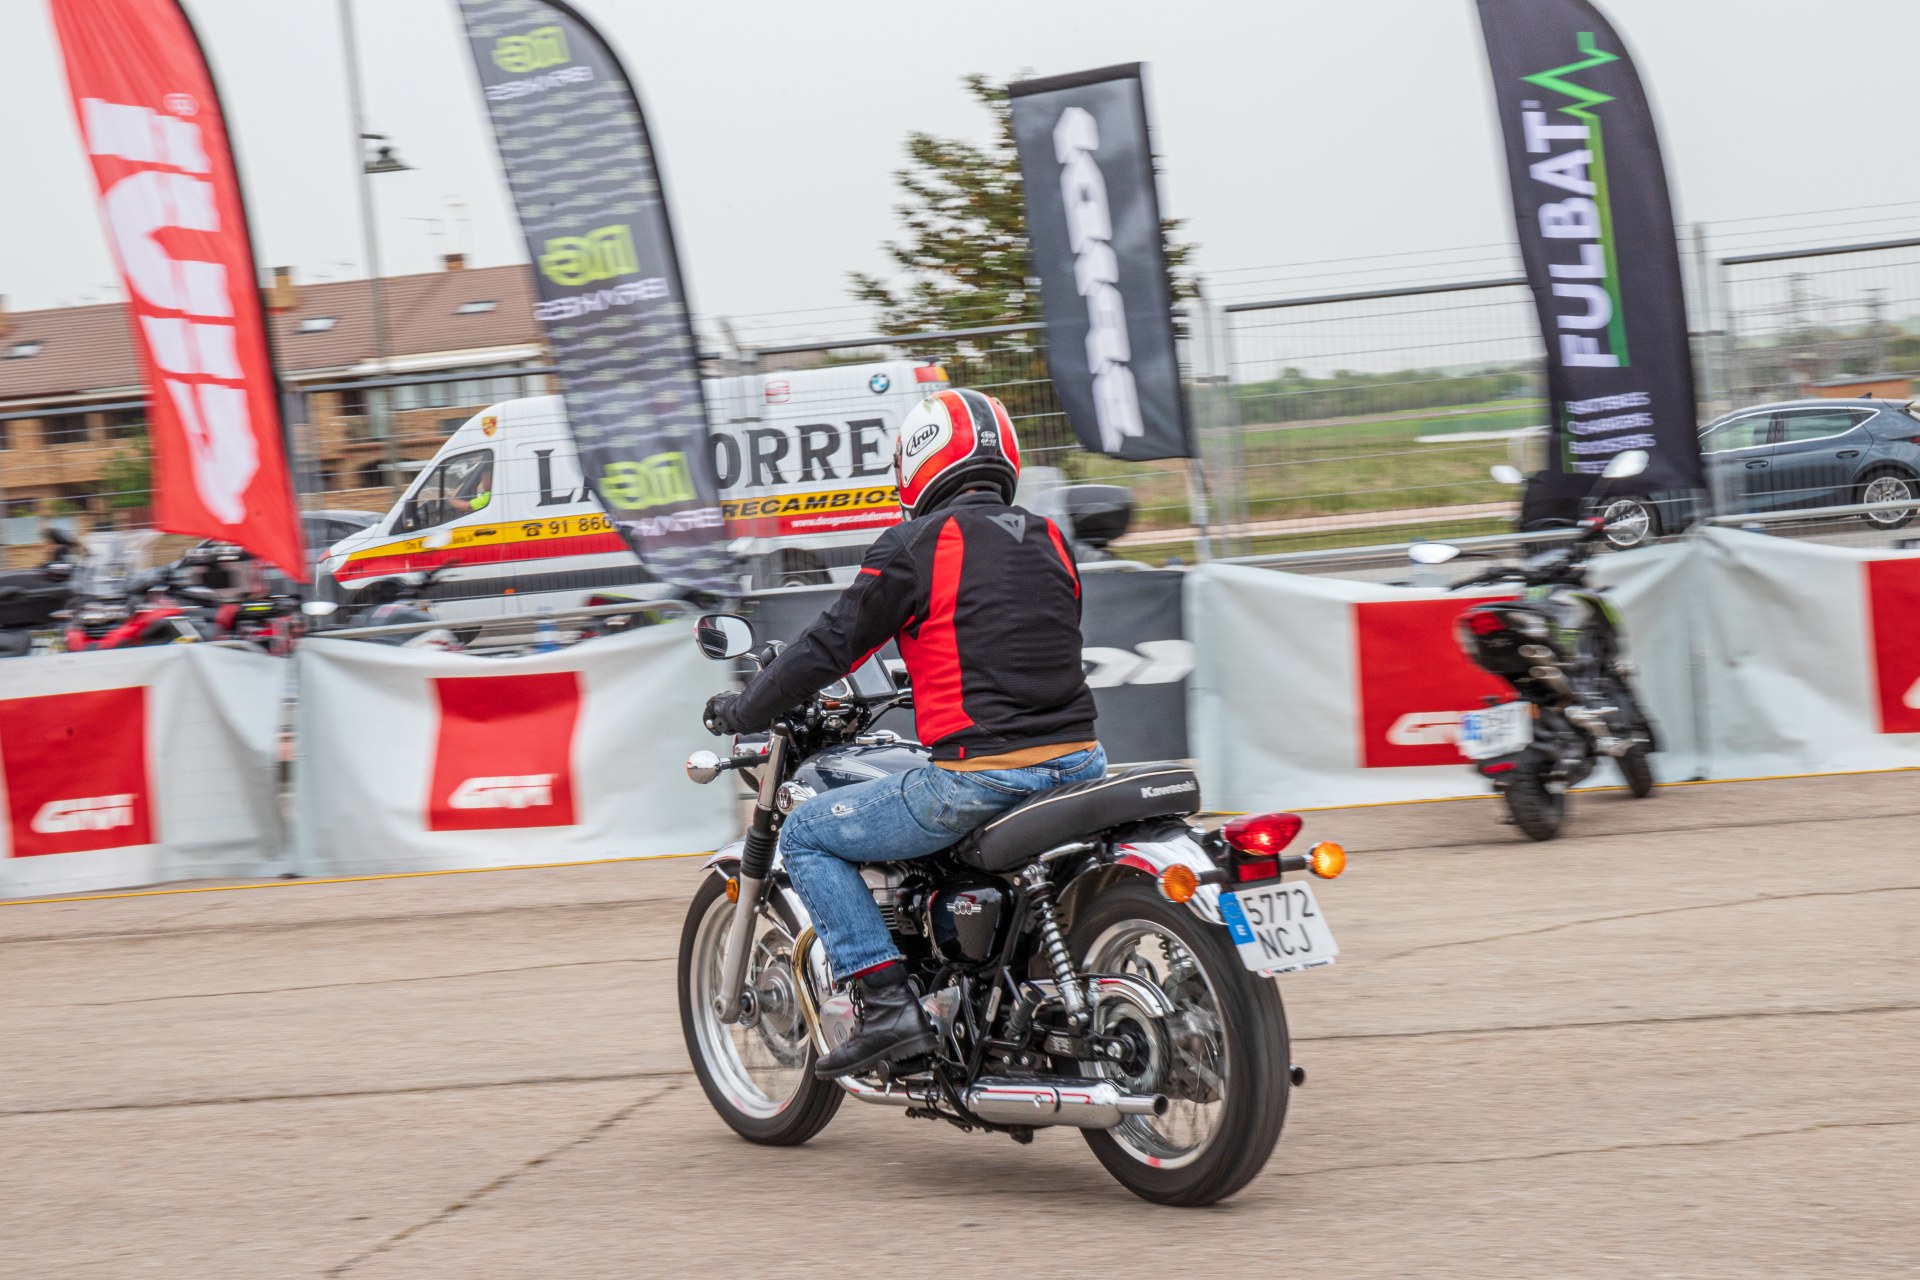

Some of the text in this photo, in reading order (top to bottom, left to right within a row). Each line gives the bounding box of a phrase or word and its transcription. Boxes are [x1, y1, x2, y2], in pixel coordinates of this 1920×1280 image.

[1522, 112, 1619, 368] FULBAT
[706, 418, 891, 489] ORRE
[910, 425, 935, 449] Arai
[549, 519, 568, 535] 91
[1141, 780, 1197, 799] Kawasaki
[1242, 888, 1315, 926] 5772
[1256, 922, 1313, 960] NCJ
